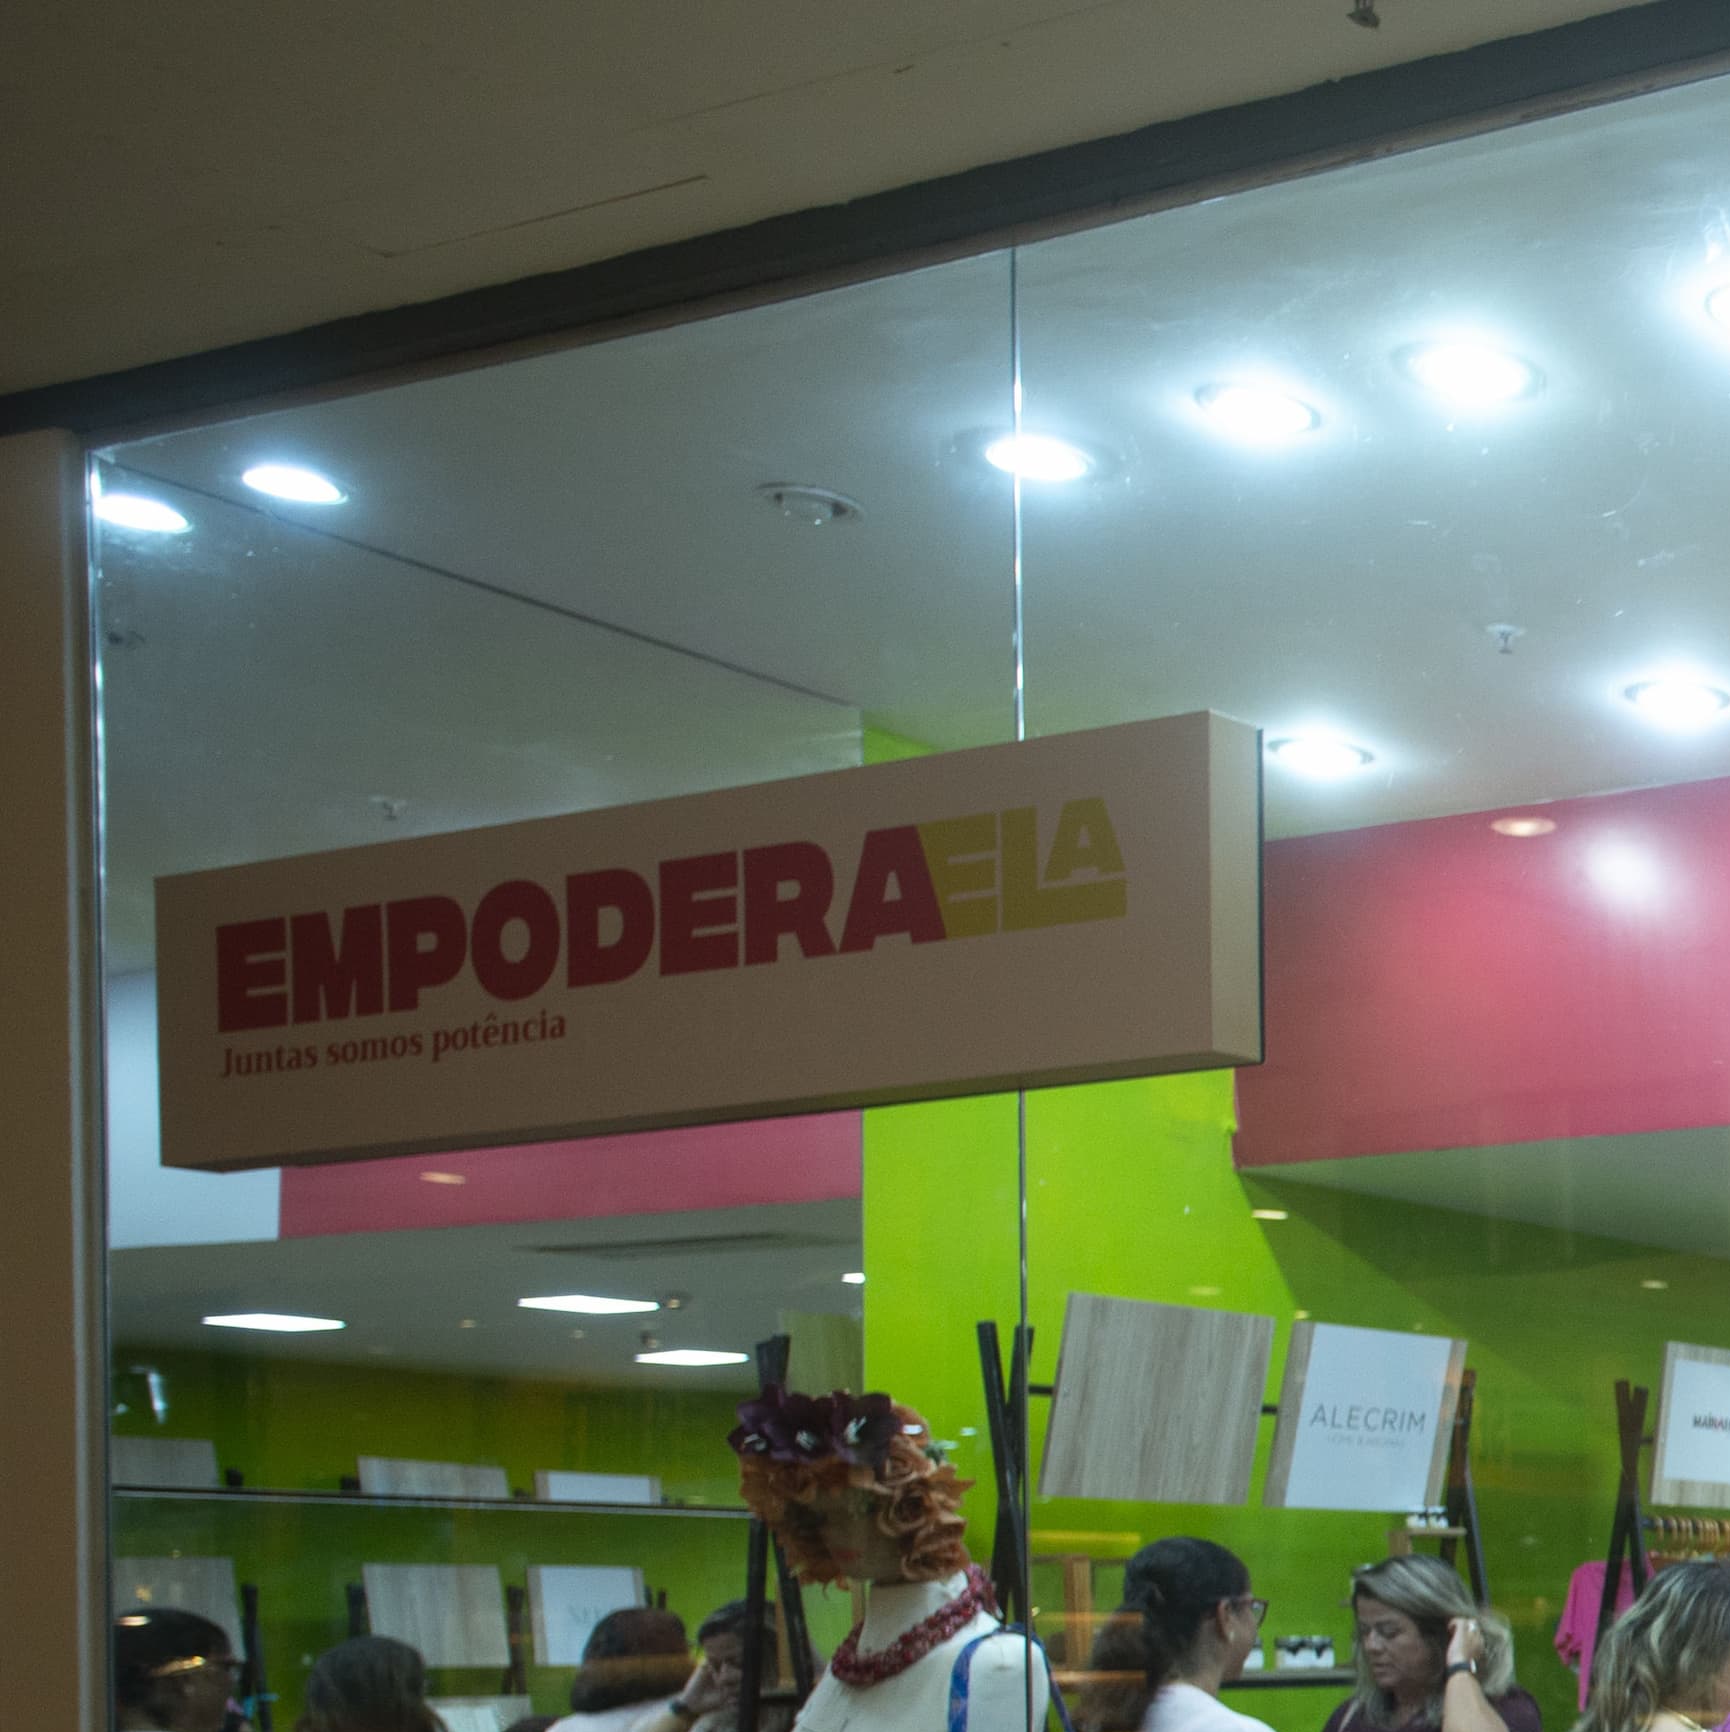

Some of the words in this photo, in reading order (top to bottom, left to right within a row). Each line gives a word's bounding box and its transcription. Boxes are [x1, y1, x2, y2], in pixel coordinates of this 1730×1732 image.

[220, 1045, 319, 1079] Juntas
[325, 1032, 424, 1066] somos
[431, 1008, 567, 1063] potência
[1309, 1401, 1428, 1434] ALECRIM
